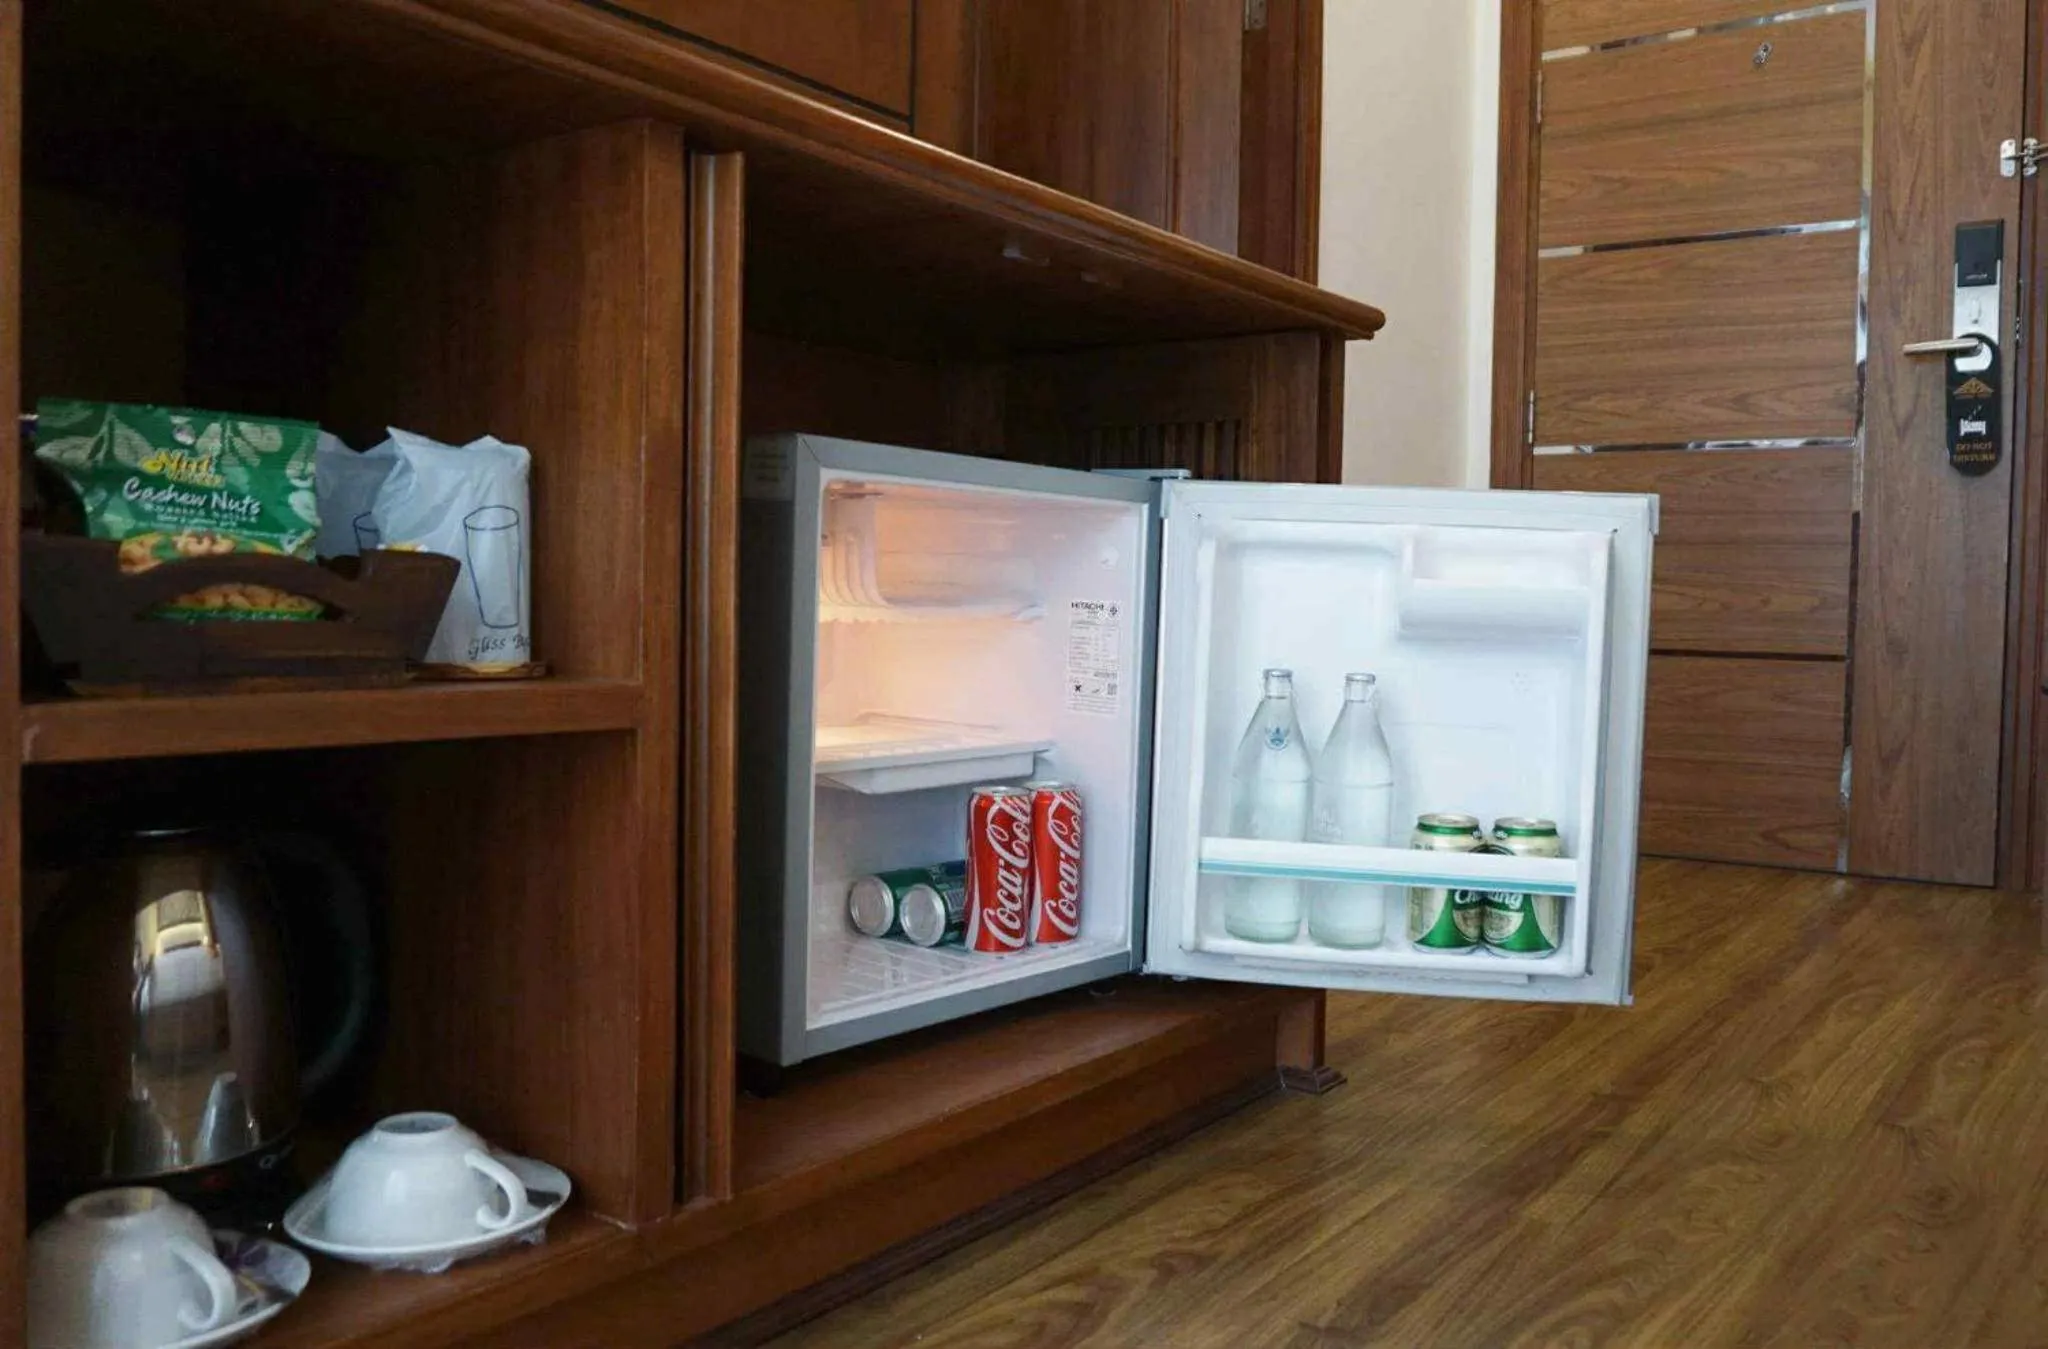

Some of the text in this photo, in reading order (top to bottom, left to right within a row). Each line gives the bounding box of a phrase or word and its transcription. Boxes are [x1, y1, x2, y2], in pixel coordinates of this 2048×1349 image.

[123, 475, 207, 506] Cashew
[210, 490, 261, 516] Nuts
[1071, 601, 1104, 611] HITACHI
